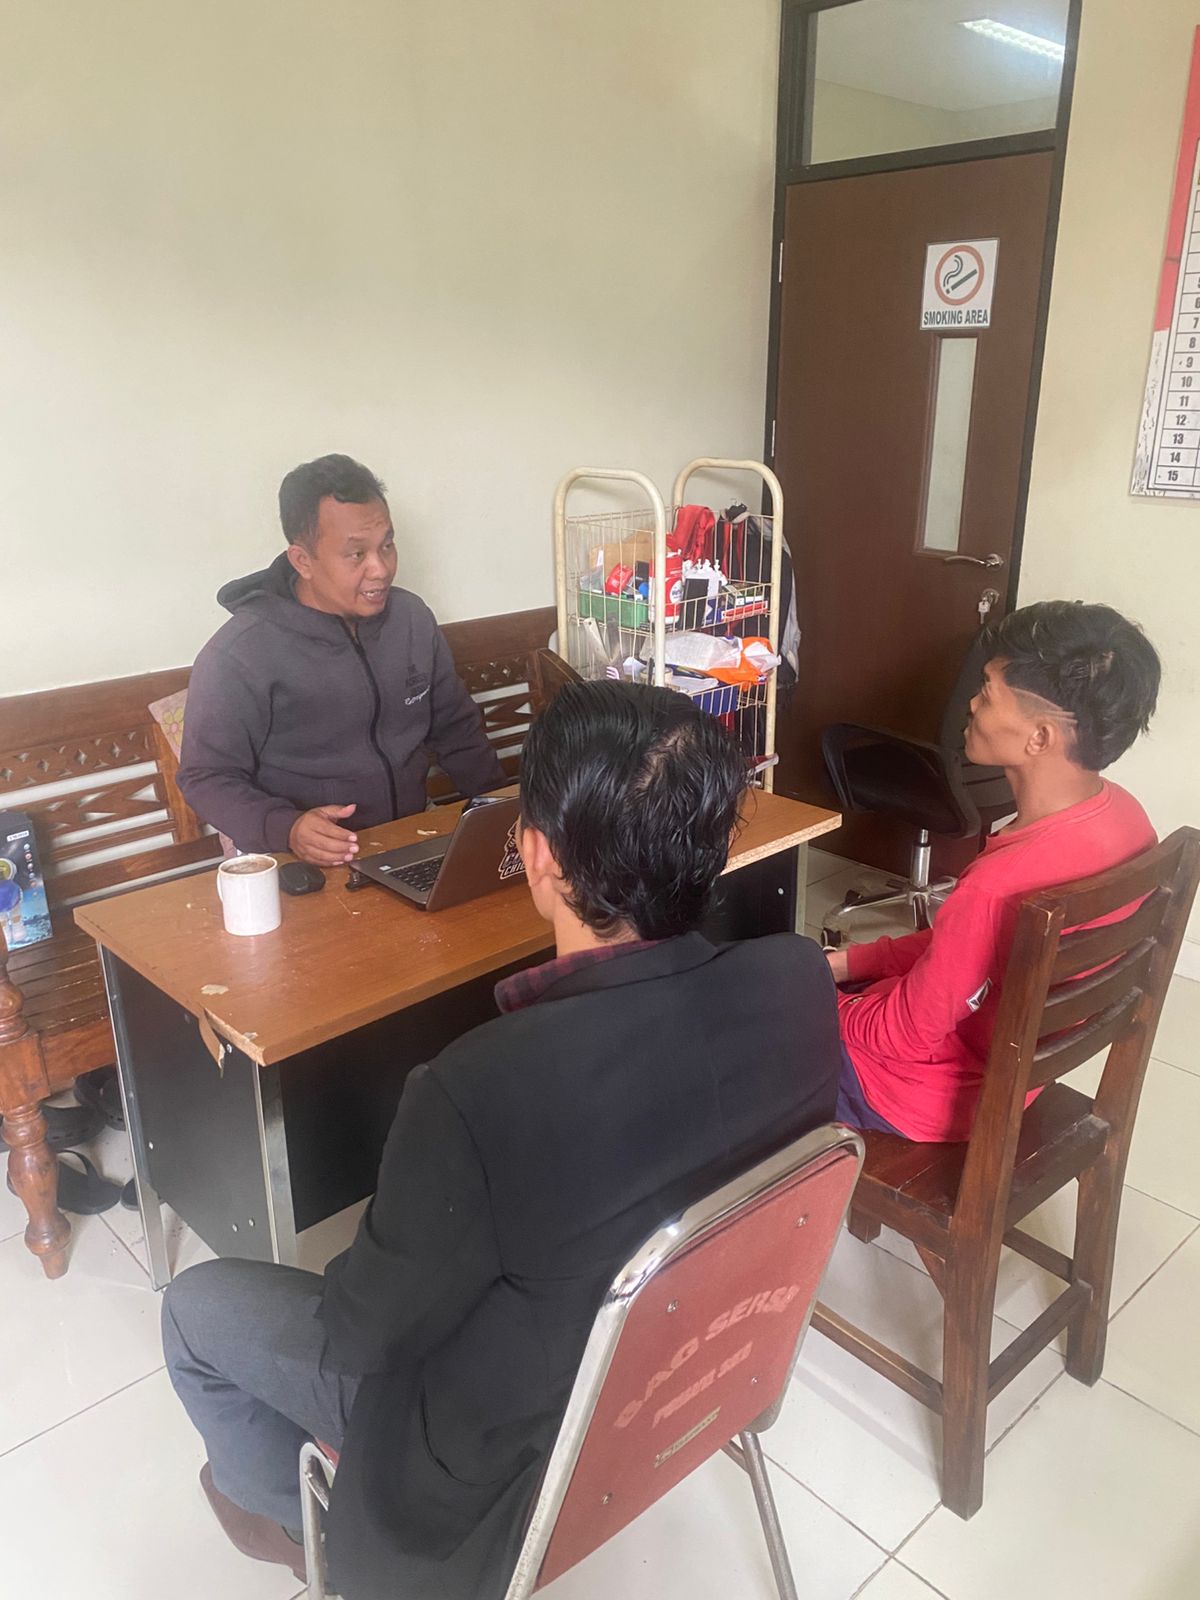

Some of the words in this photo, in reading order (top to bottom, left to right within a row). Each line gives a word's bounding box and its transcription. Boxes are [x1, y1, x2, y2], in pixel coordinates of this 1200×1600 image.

[924, 310, 963, 325] SMOKING
[964, 309, 989, 324] AREA
[1193, 317, 1199, 329] 7
[1189, 337, 1196, 349] 8
[1181, 376, 1193, 388] 10
[1179, 395, 1189, 407] 11
[1176, 414, 1187, 426] 12
[1173, 433, 1184, 445] 13
[1170, 452, 1181, 463] 14
[1167, 470, 1178, 481] 15
